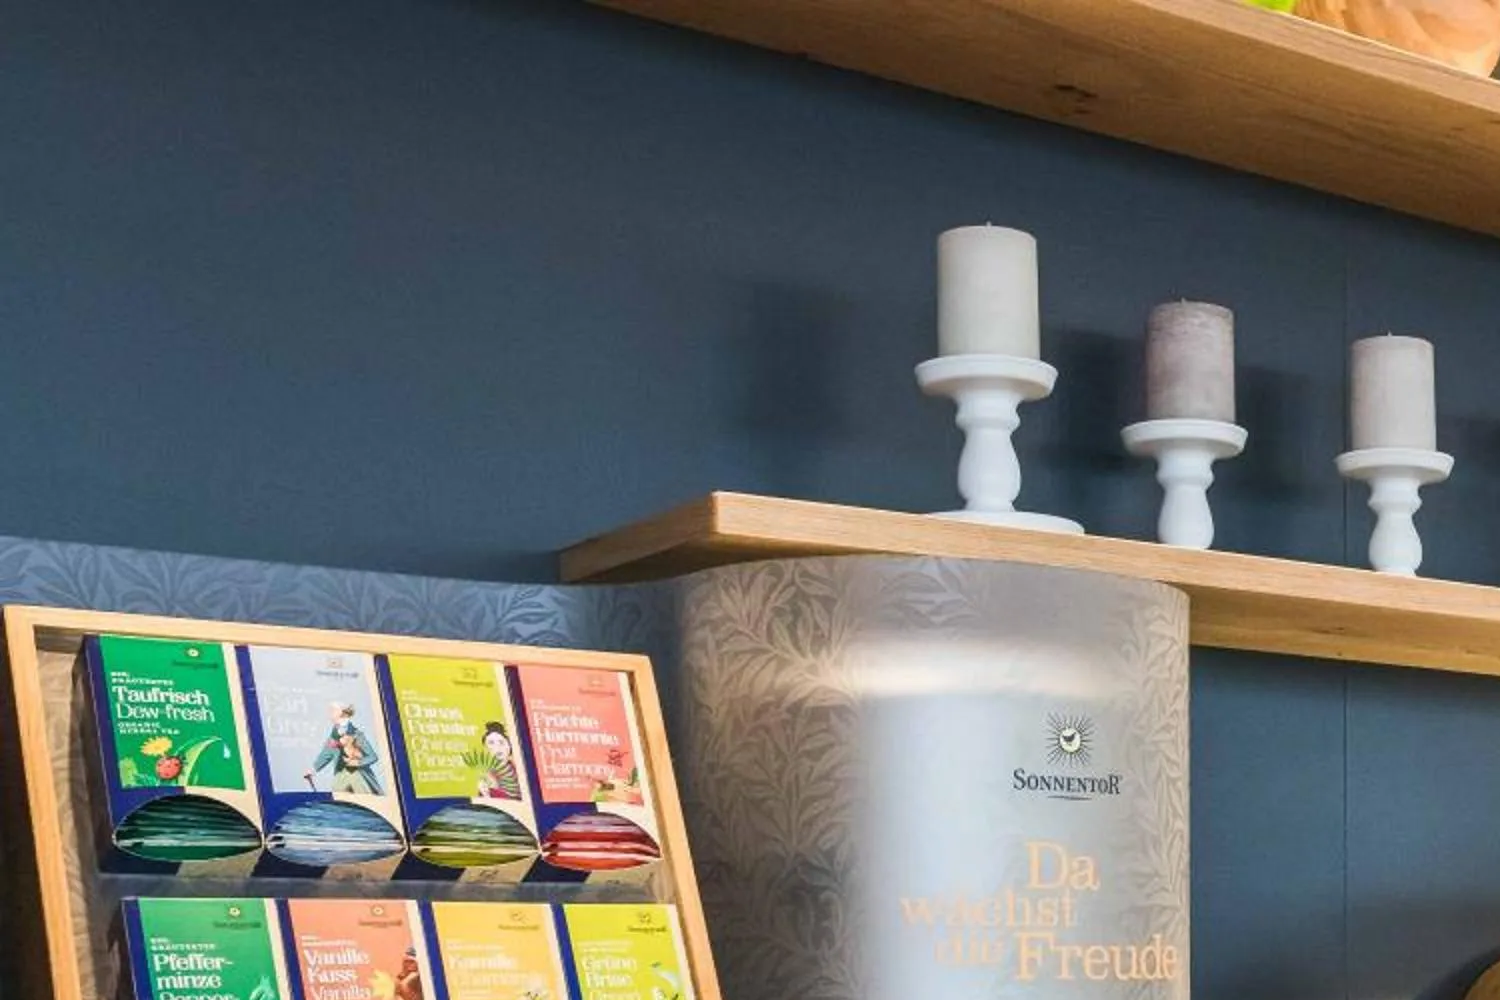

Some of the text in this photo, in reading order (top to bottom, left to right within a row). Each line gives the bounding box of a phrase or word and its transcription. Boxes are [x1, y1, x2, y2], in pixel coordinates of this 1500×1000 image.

[111, 686, 210, 707] Taufrisch
[116, 702, 216, 722] Dew-fresh
[536, 728, 619, 746] Harmonie
[543, 762, 616, 781] Harmony
[1012, 768, 1122, 795] SONNENTOR
[1024, 840, 1101, 891] Da
[153, 952, 233, 972] Pfeffer-
[303, 947, 370, 966] Vanille
[1014, 930, 1178, 982] Freude
[156, 972, 222, 990] minze
[307, 966, 357, 985] Kuss
